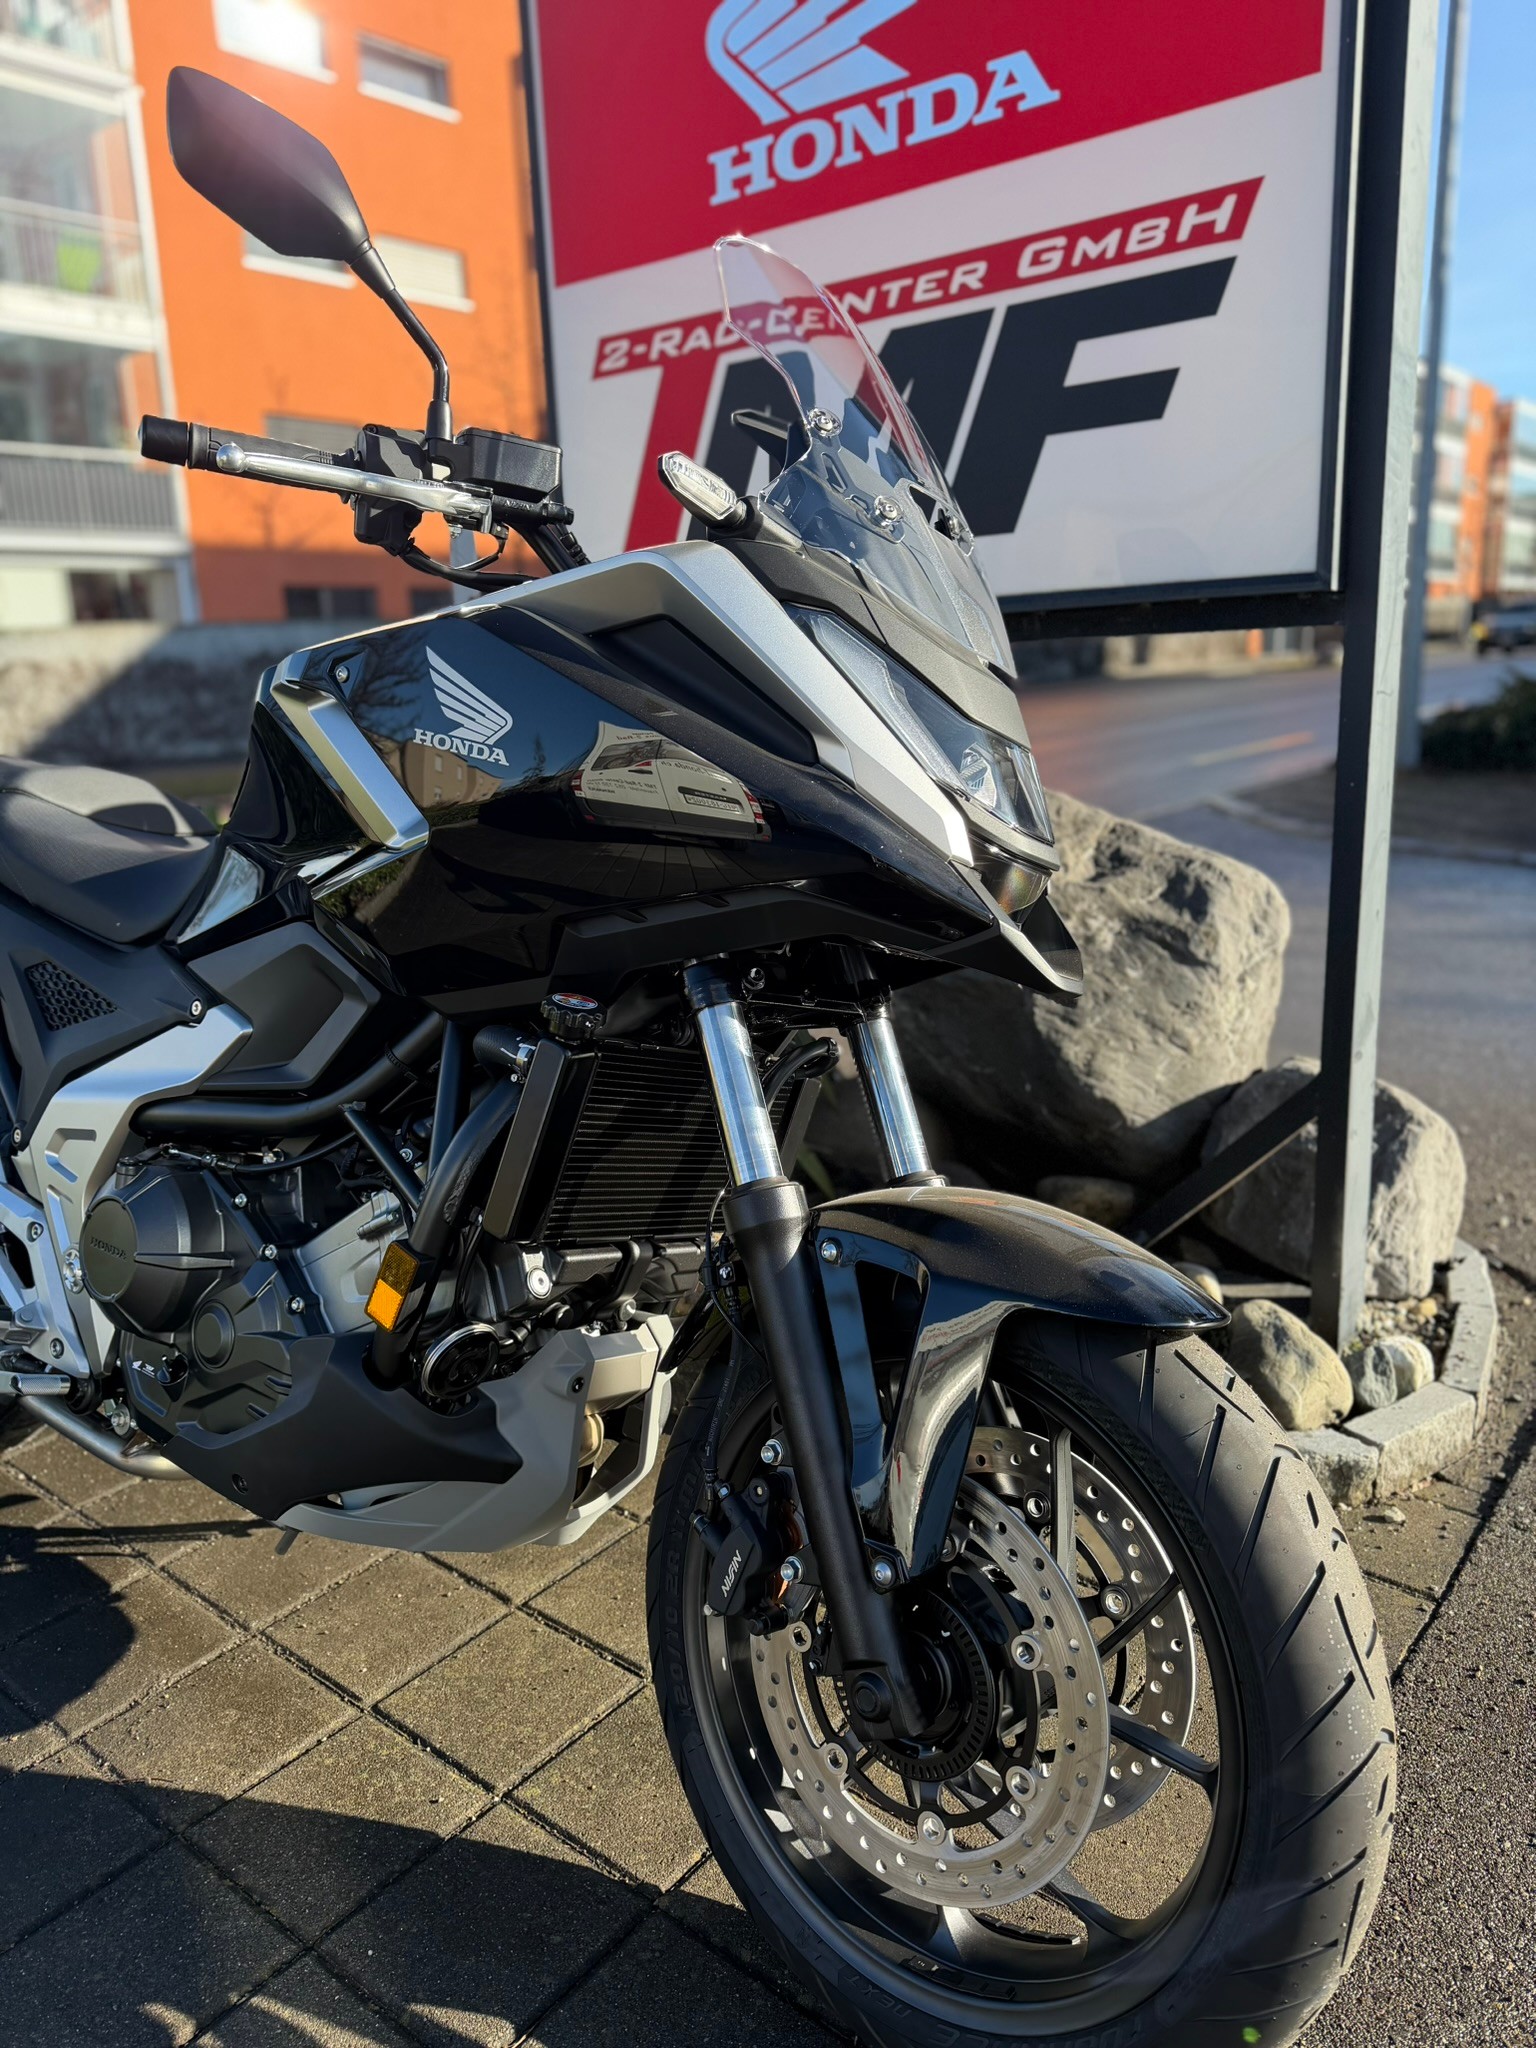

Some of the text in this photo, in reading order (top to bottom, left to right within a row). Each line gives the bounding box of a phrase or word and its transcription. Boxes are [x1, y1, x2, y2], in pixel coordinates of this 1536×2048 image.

[707, 50, 1060, 207] HONDA
[624, 256, 1237, 551] TMF
[412, 728, 510, 767] HONDA
[90, 1236, 127, 1261] HONDA
